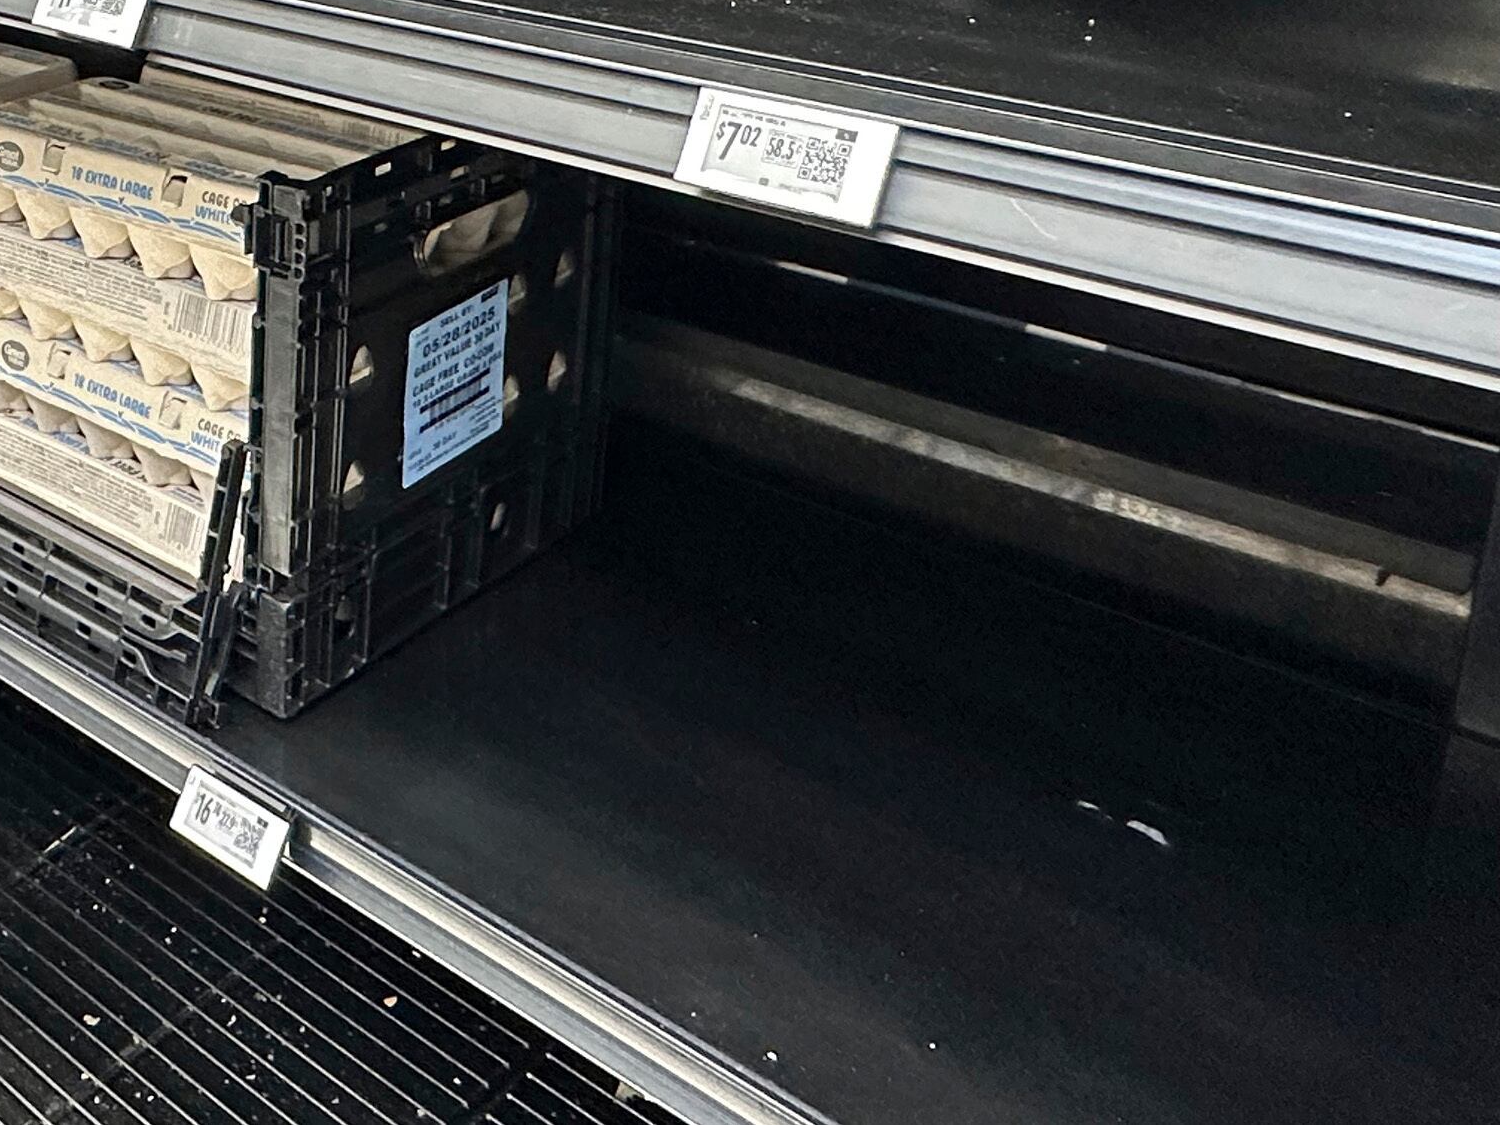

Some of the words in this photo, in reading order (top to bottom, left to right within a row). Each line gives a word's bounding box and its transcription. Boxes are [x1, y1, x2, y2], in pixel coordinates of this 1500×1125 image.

[71, 166, 82, 181] 18
[84, 171, 118, 189] EXTRA
[120, 179, 154, 200] LARGE
[202, 190, 230, 209] CAGE
[422, 306, 495, 358] 05/28/2025
[86, 377, 118, 402] EXTRA
[120, 393, 152, 419] LARGE
[191, 431, 220, 453] WHIT
[198, 418, 225, 440] CAGE
